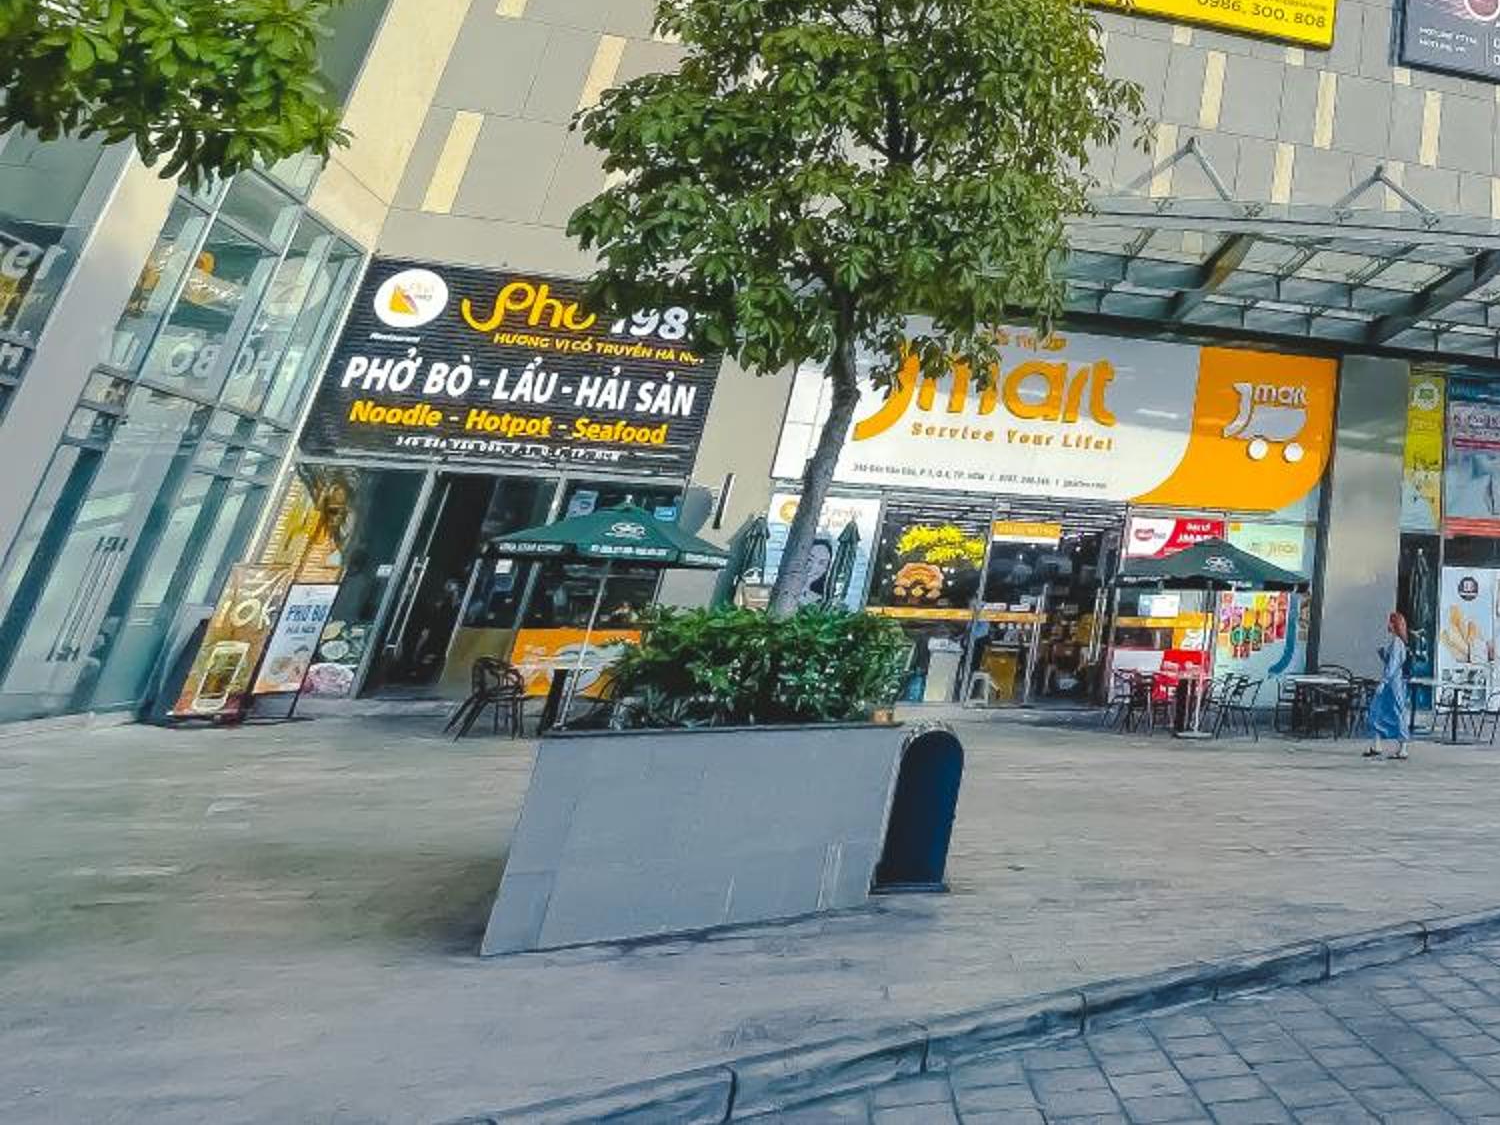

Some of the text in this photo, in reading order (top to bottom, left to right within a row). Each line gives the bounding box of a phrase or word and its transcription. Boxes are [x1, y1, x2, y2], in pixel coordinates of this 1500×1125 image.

[1294, 12, 1326, 29] 808
[341, 346, 423, 392] PHỞ
[423, 354, 474, 398] BÒ
[492, 356, 559, 404] LẨU
[574, 366, 631, 411] HẢI
[635, 370, 697, 416] SẢN
[350, 400, 443, 427] Noodle
[465, 408, 552, 438] Hotpot
[572, 417, 668, 444] Seafood
[1223, 382, 1310, 438] Jmart
[911, 421, 1113, 452] Service Your Life!
